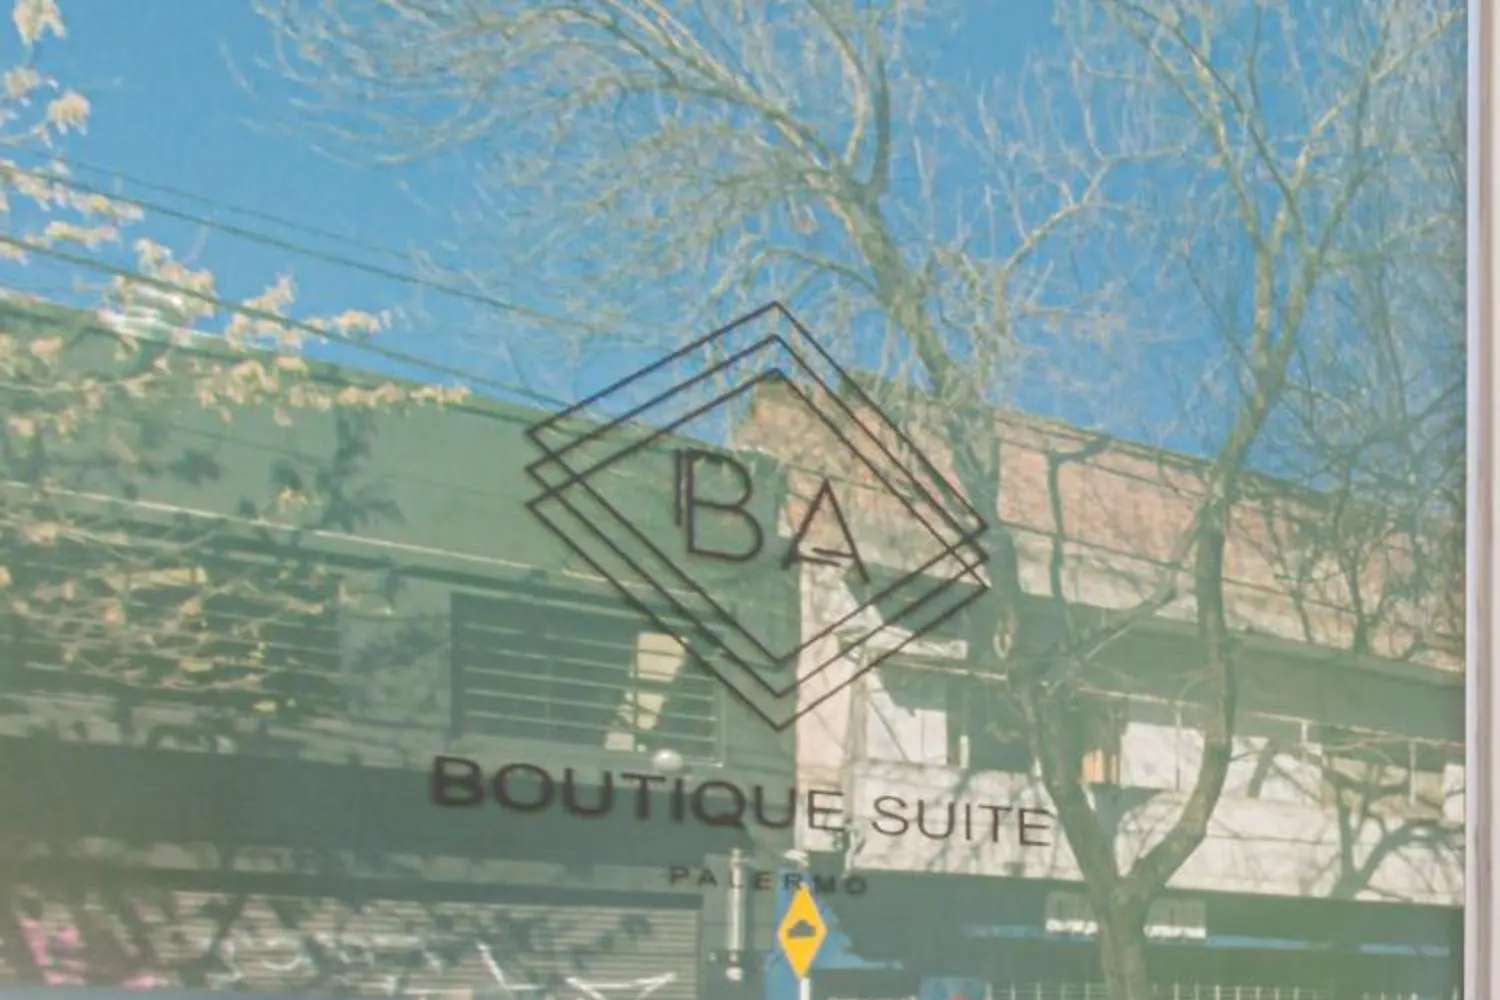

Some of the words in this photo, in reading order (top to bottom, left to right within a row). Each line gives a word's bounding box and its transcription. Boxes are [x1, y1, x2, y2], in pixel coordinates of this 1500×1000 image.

[674, 446, 871, 585] BA
[430, 754, 844, 833] BOUTIQUE
[872, 795, 1055, 847] SUITE
[669, 865, 867, 895] PALERMO
